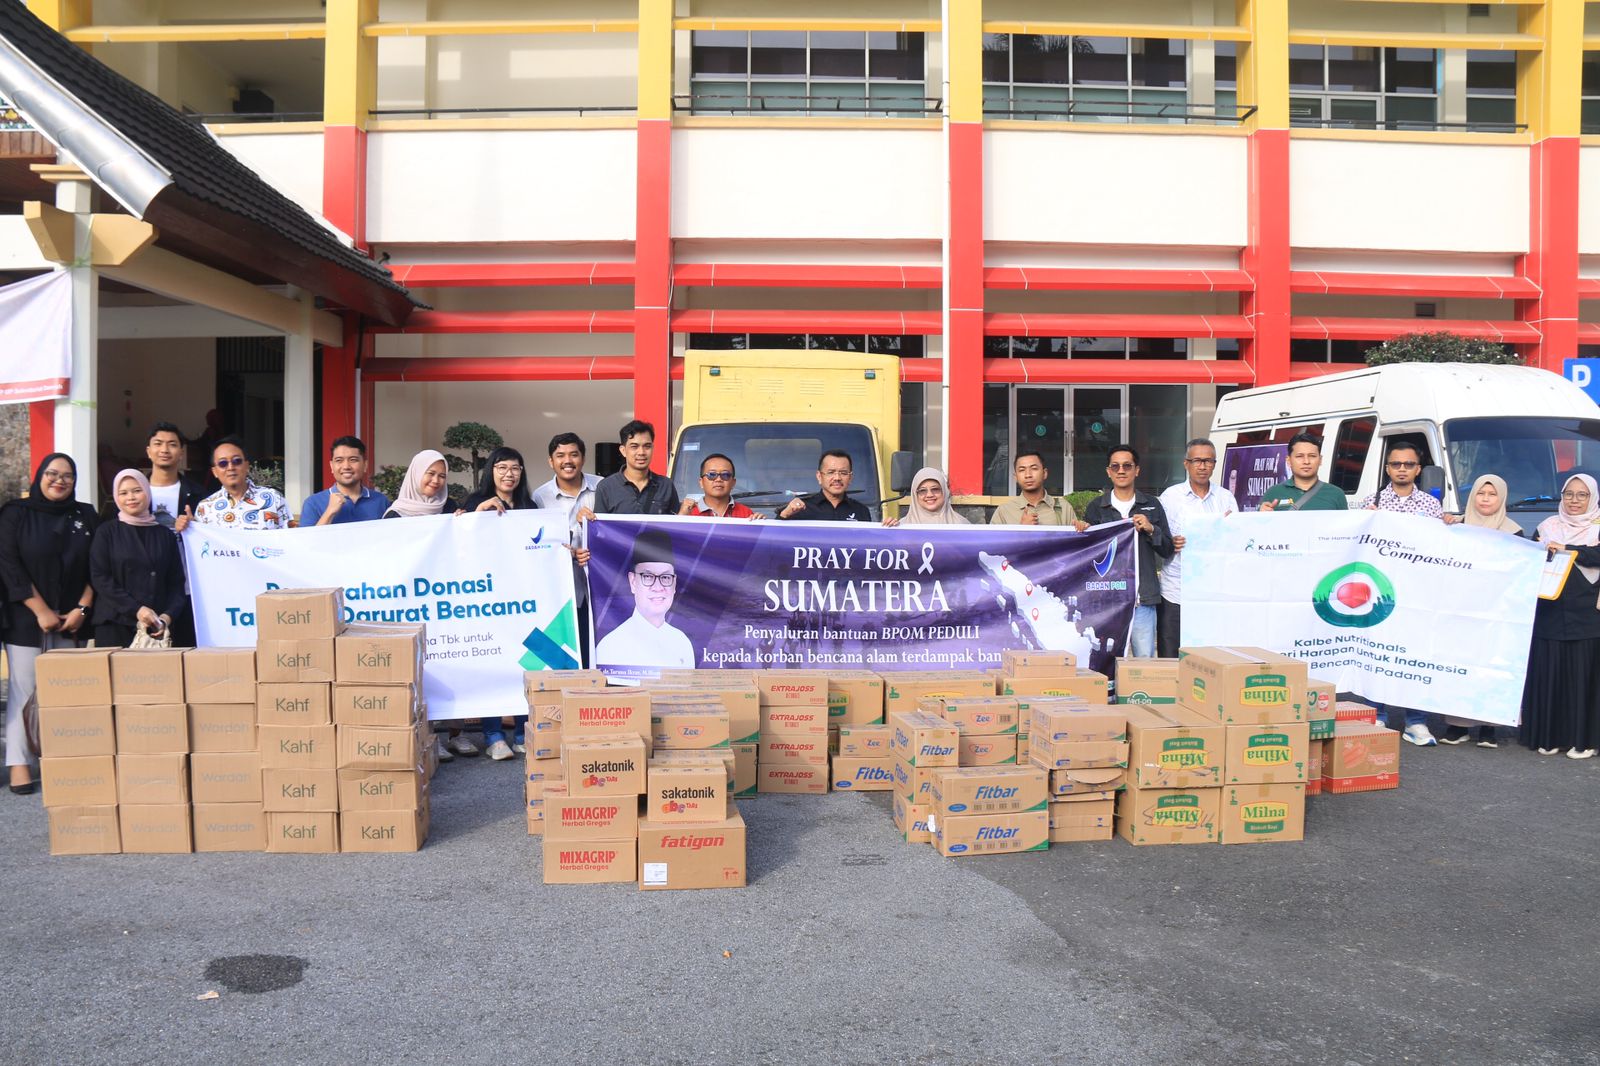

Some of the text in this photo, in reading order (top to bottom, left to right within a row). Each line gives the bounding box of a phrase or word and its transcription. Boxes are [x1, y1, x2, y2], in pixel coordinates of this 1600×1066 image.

[1572, 365, 1591, 388] P
[1359, 534, 1402, 549] Hopes
[213, 549, 240, 557] KALBE
[792, 547, 909, 570] PRAY FOR
[1379, 546, 1472, 569] Compassion
[414, 573, 493, 596] Donasi
[1086, 581, 1127, 590] BADAN POM
[764, 579, 951, 612] SUMATERA
[437, 599, 536, 619] Bencana
[276, 610, 312, 625] Kahf
[440, 634, 460, 644] Tbk
[463, 632, 494, 643] untuk
[744, 625, 980, 645] Penyaluran bantuan BPOM PEDULI
[1294, 635, 1407, 654] Kalbe Nutritionals
[276, 653, 312, 668] Kahf
[357, 653, 392, 667] Kahf
[425, 647, 502, 660] umatera Barat
[703, 648, 1010, 669] kepada korban bencana alam terdampak ban
[1300, 646, 1355, 658] Harapan
[1395, 656, 1467, 676] Indonesia
[1310, 659, 1432, 685] Bencana di Padang
[353, 696, 388, 709] Kahf
[1244, 690, 1288, 702] Milna
[275, 698, 310, 712] Kahf
[579, 707, 632, 719] MIXAGRIP
[976, 714, 991, 722] Zee
[280, 739, 314, 753] Kahf
[357, 741, 392, 756] Kahf
[920, 745, 955, 756] Fitbar
[1247, 748, 1290, 762] Milna
[582, 759, 634, 773] sakatonik
[768, 771, 814, 779] EXTRAJOSS
[282, 783, 316, 798] Kahf
[359, 781, 394, 796] Kahf
[661, 787, 714, 799] sakatonik
[975, 785, 1019, 800] Fitbar
[561, 806, 618, 820] MIXAGRIP
[1244, 806, 1285, 818] Milna
[586, 820, 611, 828] Greges
[282, 825, 316, 839] Kahf
[361, 825, 395, 840] Kahf
[976, 826, 1019, 840] Fitbar
[661, 835, 724, 850] fatigon
[559, 850, 616, 863] MIXAGRIP
[584, 864, 609, 872] Greges
